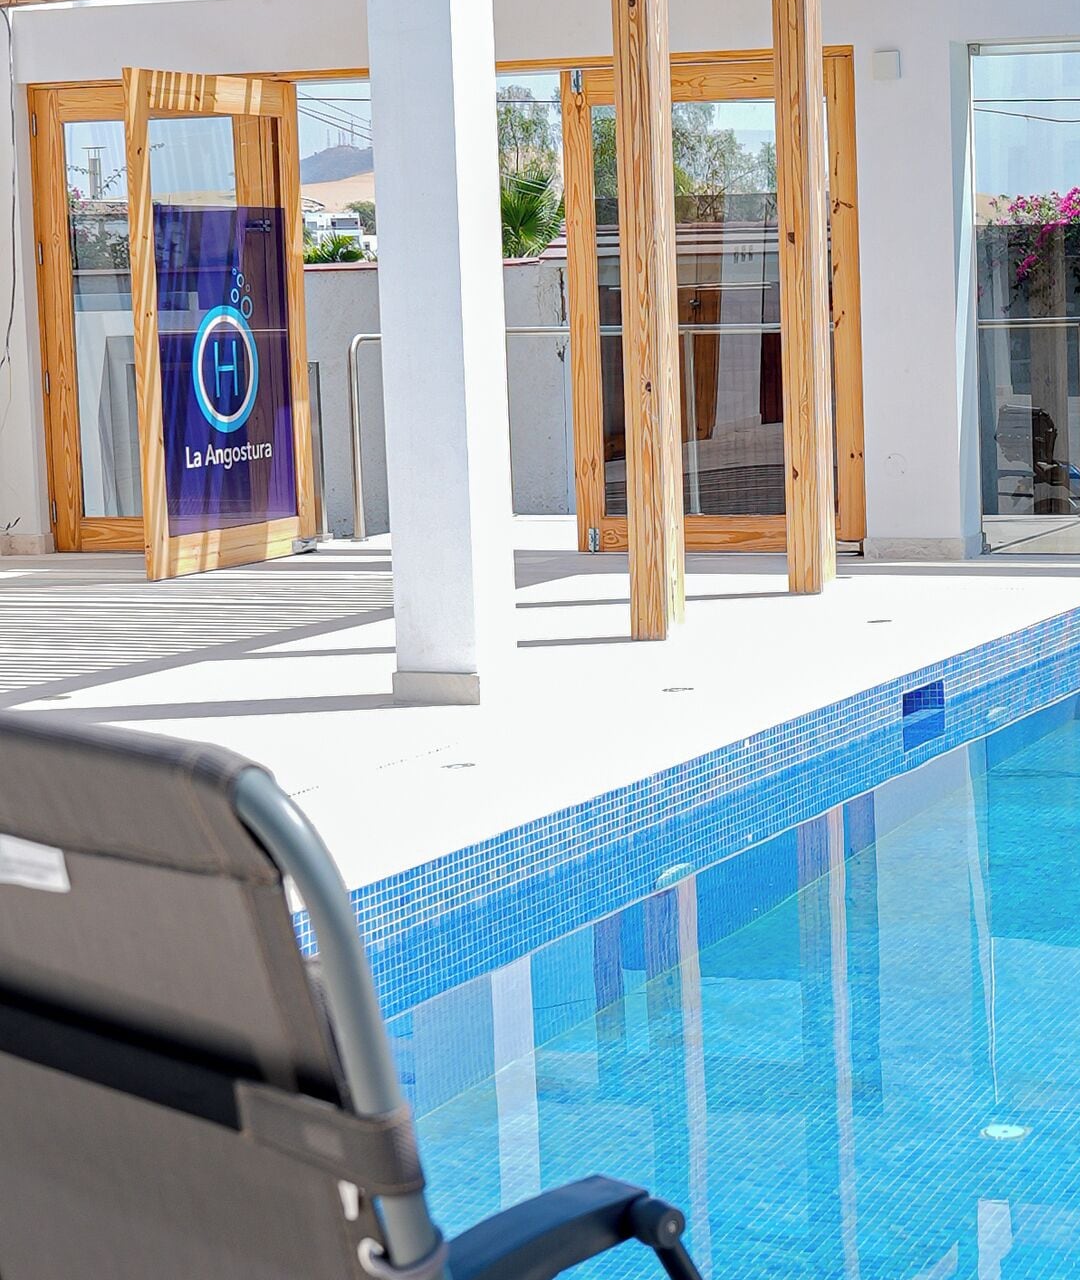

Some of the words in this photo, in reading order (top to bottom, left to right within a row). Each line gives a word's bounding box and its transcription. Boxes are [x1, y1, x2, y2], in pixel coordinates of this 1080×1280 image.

[214, 340, 238, 398] H
[185, 446, 202, 469] La
[204, 441, 273, 470] Angostura
